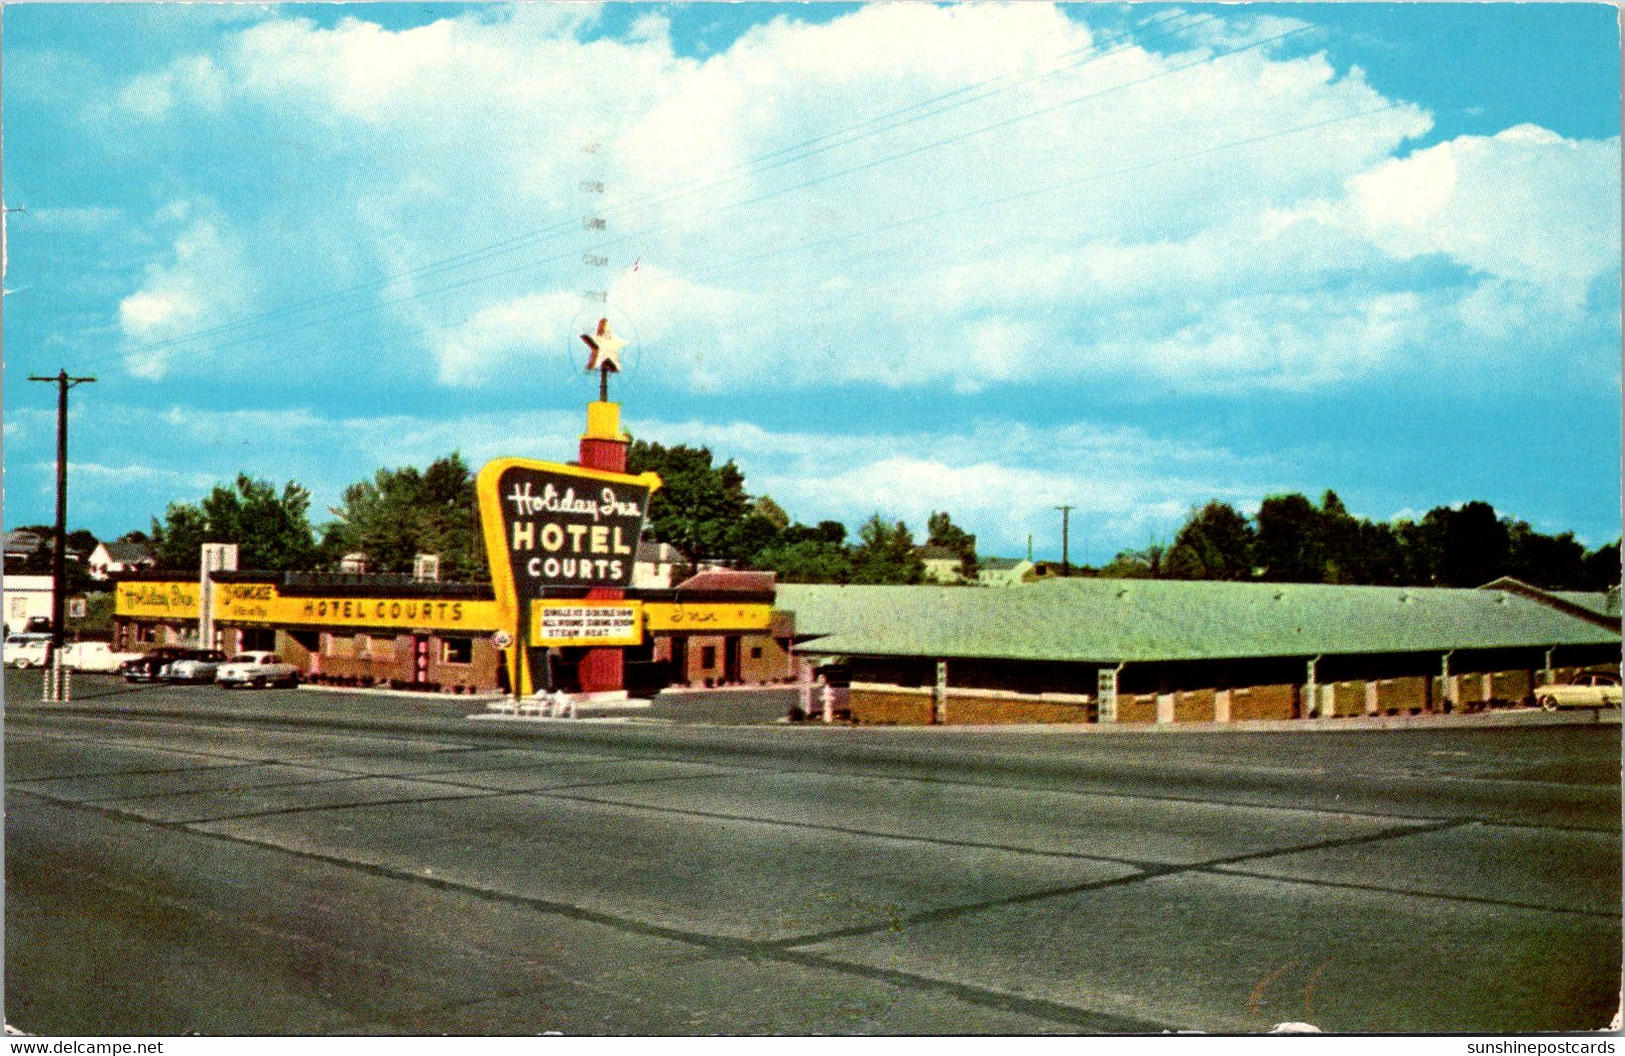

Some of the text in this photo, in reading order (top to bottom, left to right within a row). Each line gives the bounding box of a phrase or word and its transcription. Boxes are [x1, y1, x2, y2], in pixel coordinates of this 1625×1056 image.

[507, 482, 641, 522] Holiday Inn
[513, 521, 631, 555] HOTEL
[527, 557, 624, 580] COURTS
[303, 601, 463, 622] HOTEL COURTS
